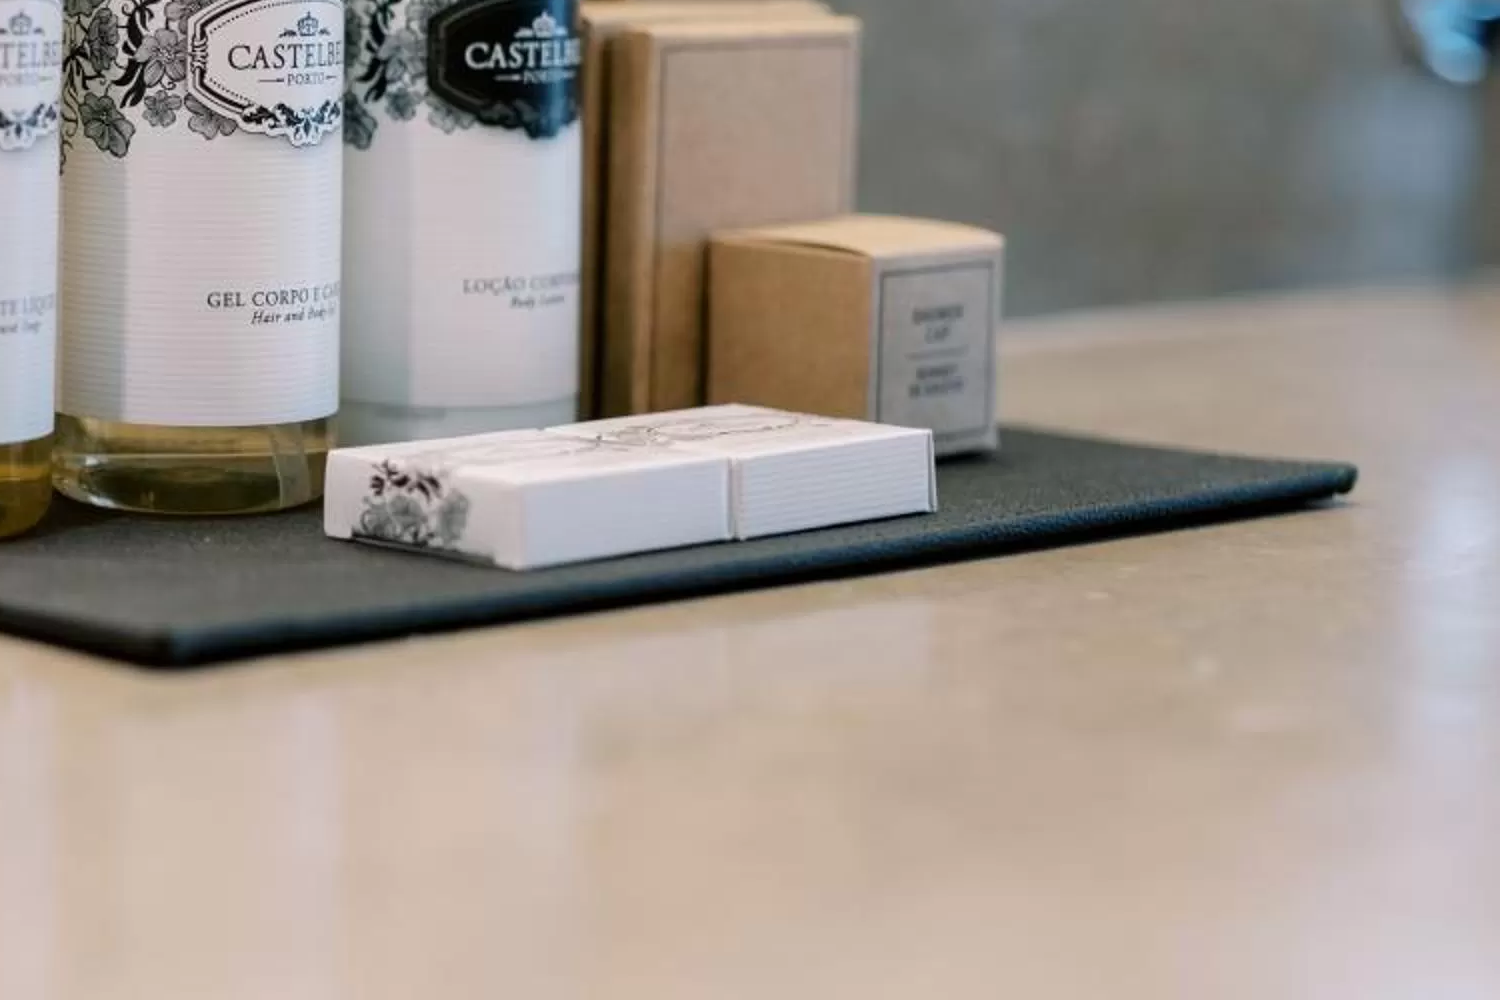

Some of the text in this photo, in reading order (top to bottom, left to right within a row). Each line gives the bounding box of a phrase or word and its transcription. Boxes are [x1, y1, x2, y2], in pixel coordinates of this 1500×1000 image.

[287, 72, 325, 87] PORTO
[207, 291, 245, 308] GEL
[252, 287, 309, 307] CORPO
[250, 309, 282, 326] Hair
